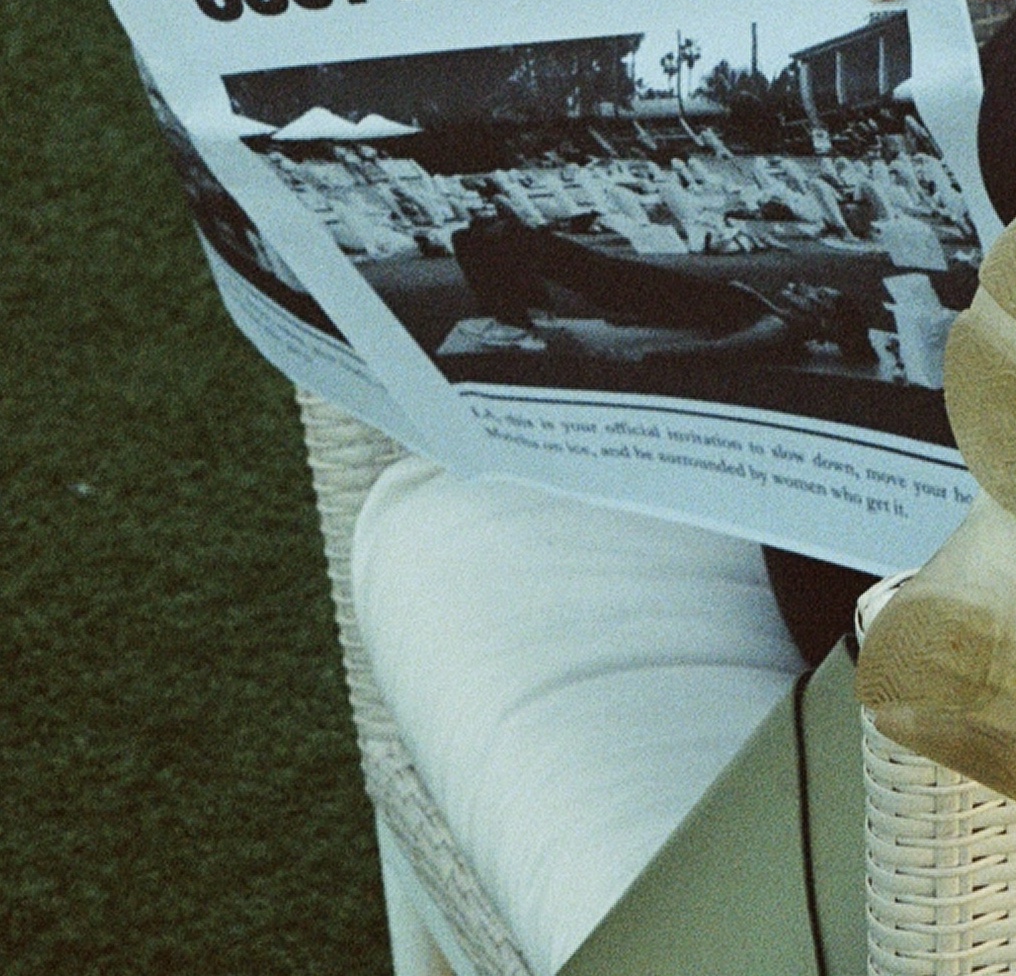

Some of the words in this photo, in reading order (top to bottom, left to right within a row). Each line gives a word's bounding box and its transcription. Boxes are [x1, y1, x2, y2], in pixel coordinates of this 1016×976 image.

[560, 420, 598, 435] your
[605, 422, 662, 439] official
[667, 428, 743, 452] invitation
[747, 440, 765, 455] to
[771, 444, 805, 463] slow
[812, 451, 861, 479] down,
[865, 467, 907, 490] move
[913, 480, 948, 499] your
[601, 444, 631, 459] and
[632, 444, 654, 461] be
[657, 451, 746, 478] surrounded
[747, 464, 768, 487] by
[772, 474, 828, 498] women
[830, 486, 863, 506] who
[865, 495, 891, 514] get
[892, 499, 910, 519] it.
